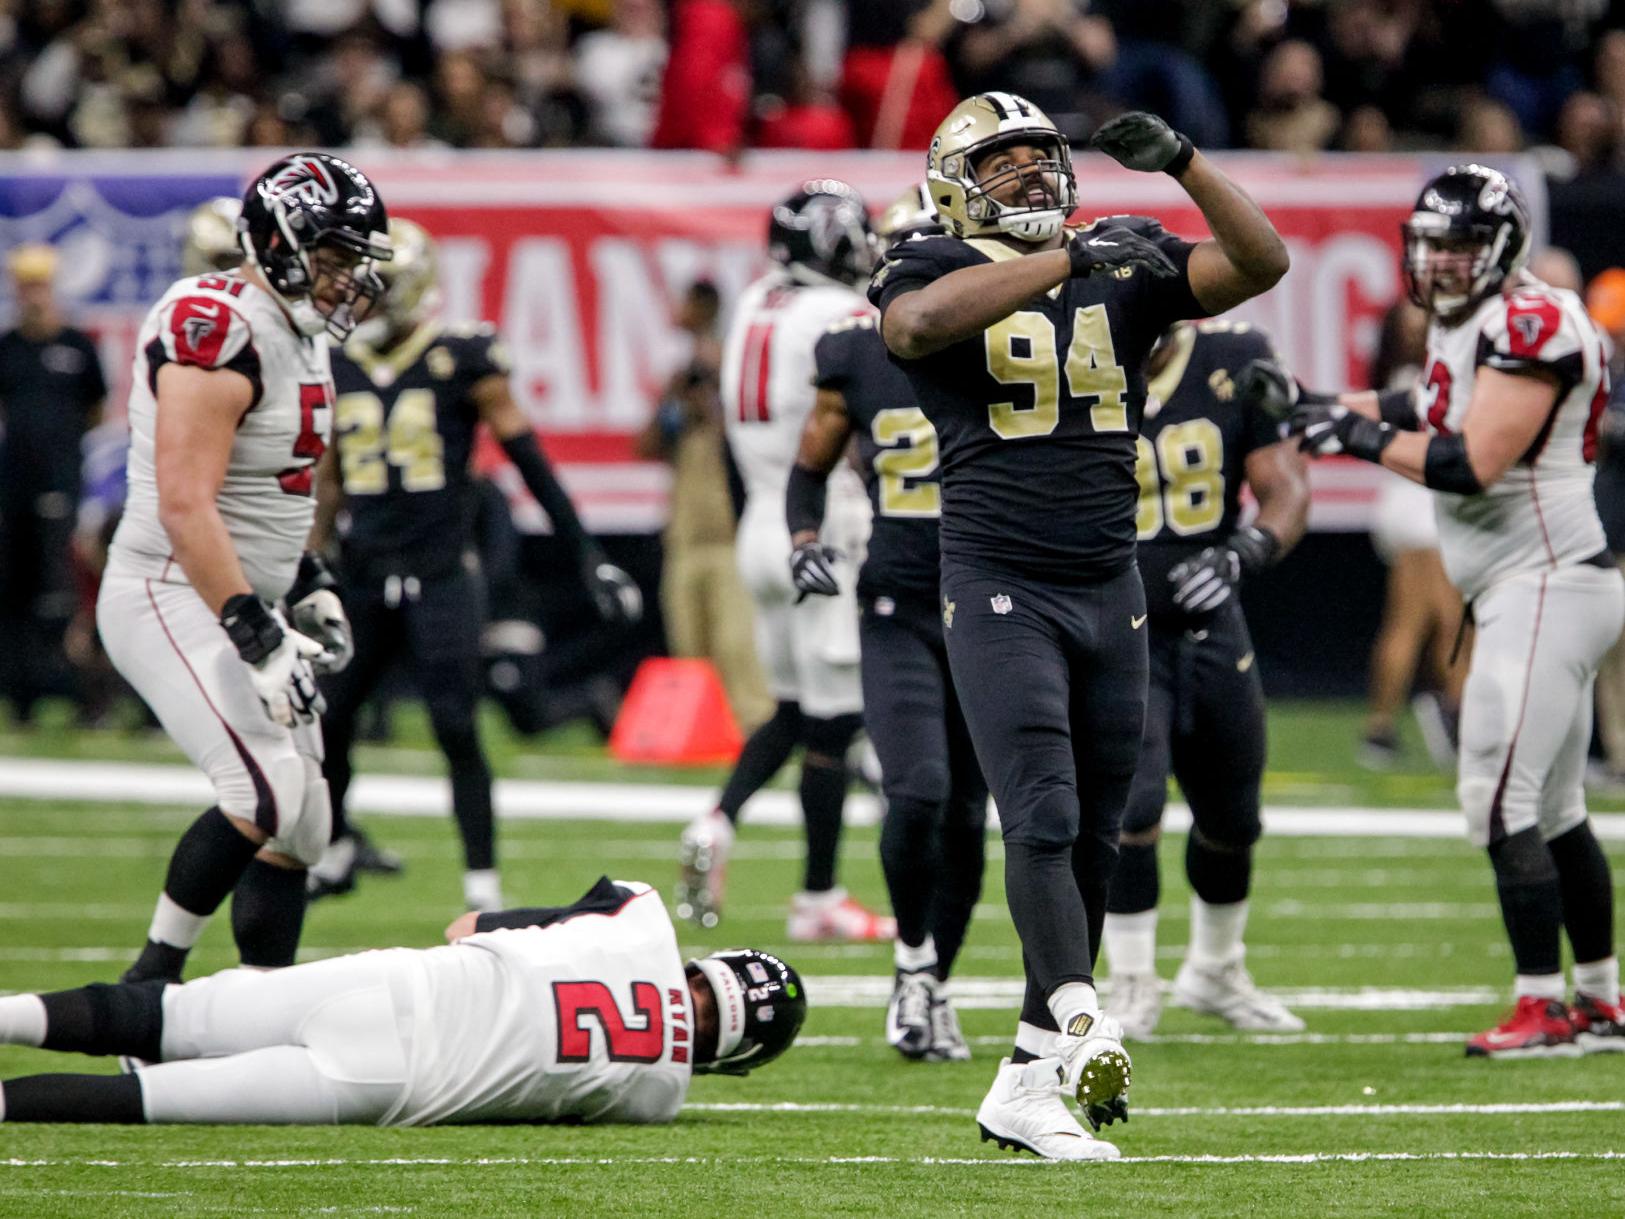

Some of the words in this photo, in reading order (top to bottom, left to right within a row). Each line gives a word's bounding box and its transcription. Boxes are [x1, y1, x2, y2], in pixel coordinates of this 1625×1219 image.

[985, 303, 1129, 440] 94
[277, 382, 337, 497] 5
[334, 388, 446, 494] 24
[871, 407, 942, 518] 2
[552, 981, 664, 1064] 2
[667, 988, 689, 1064] RYAN
[747, 987, 769, 1002] 2
